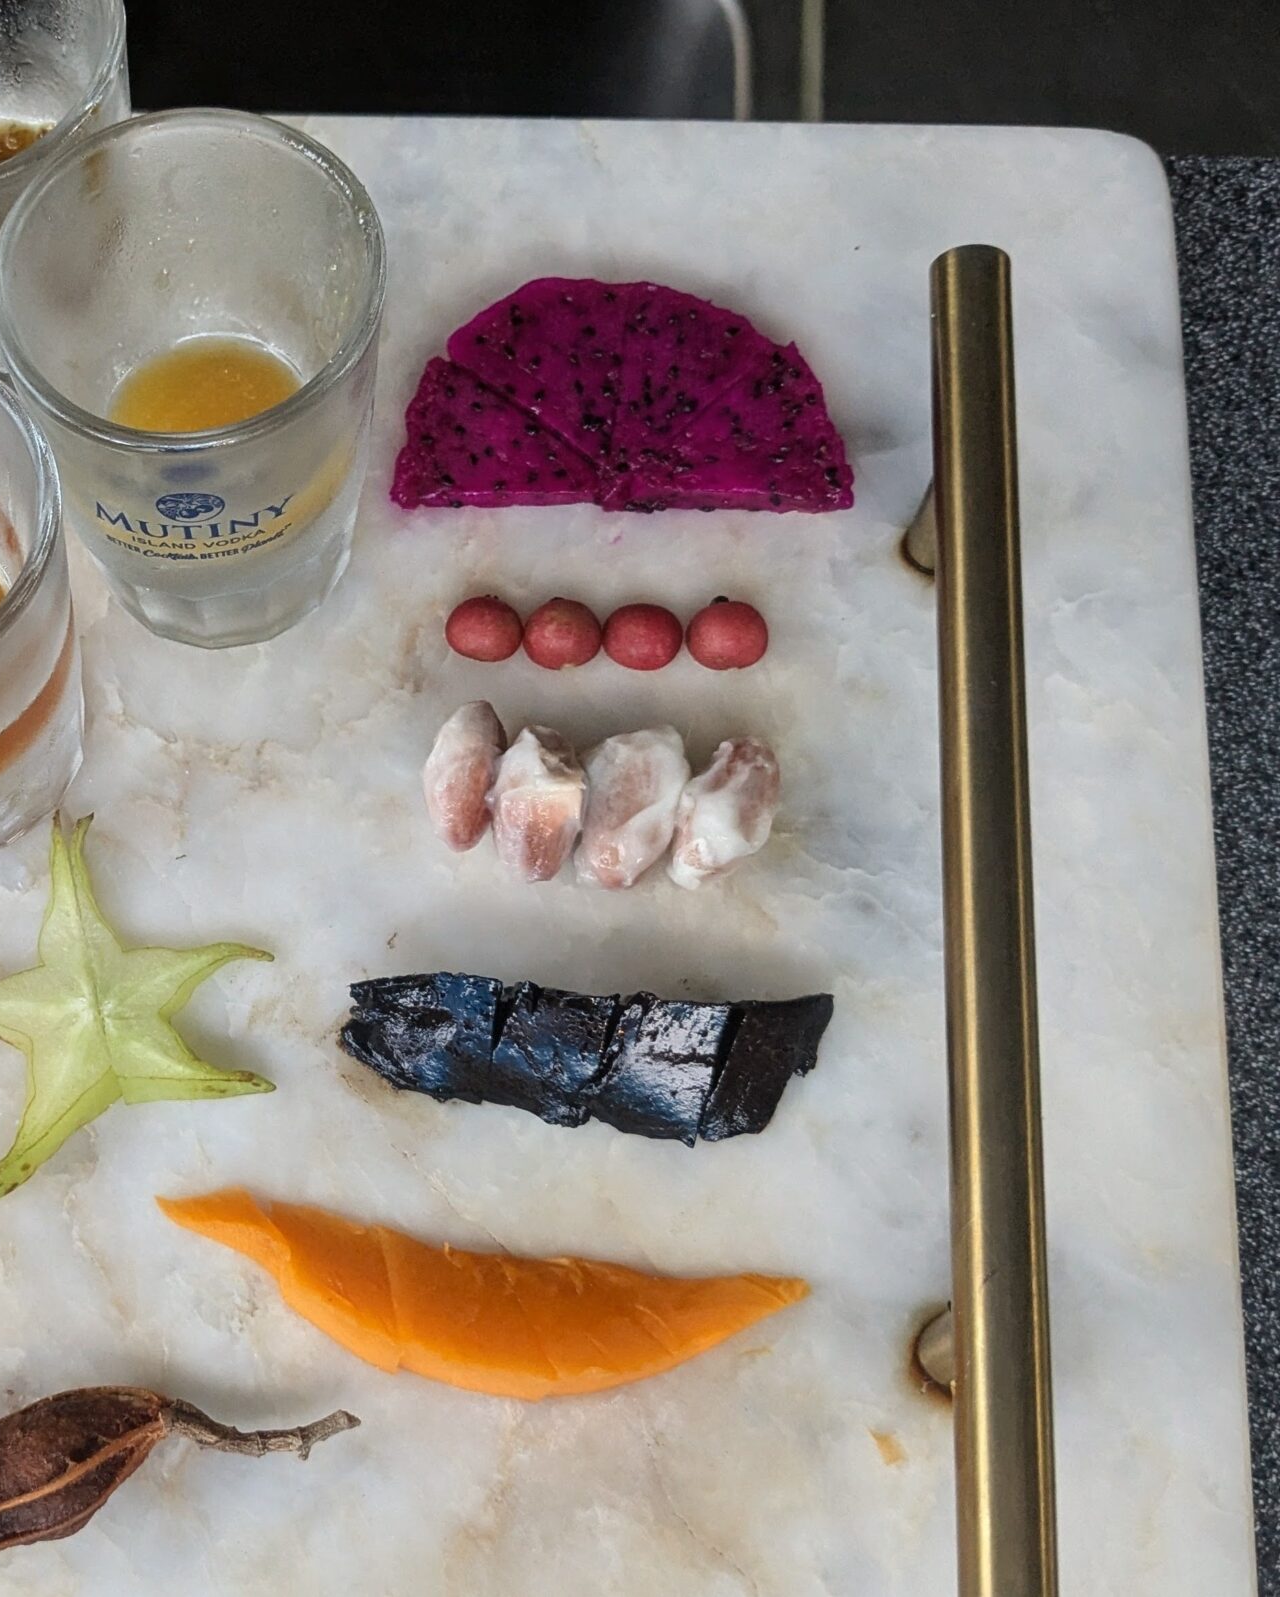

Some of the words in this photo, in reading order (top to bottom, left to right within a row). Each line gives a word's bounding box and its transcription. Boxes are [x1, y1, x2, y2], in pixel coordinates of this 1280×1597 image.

[95, 493, 294, 540] MUTINY
[131, 536, 196, 549] ISLAND
[203, 529, 266, 548] VODKA
[200, 548, 240, 560] BETTER
